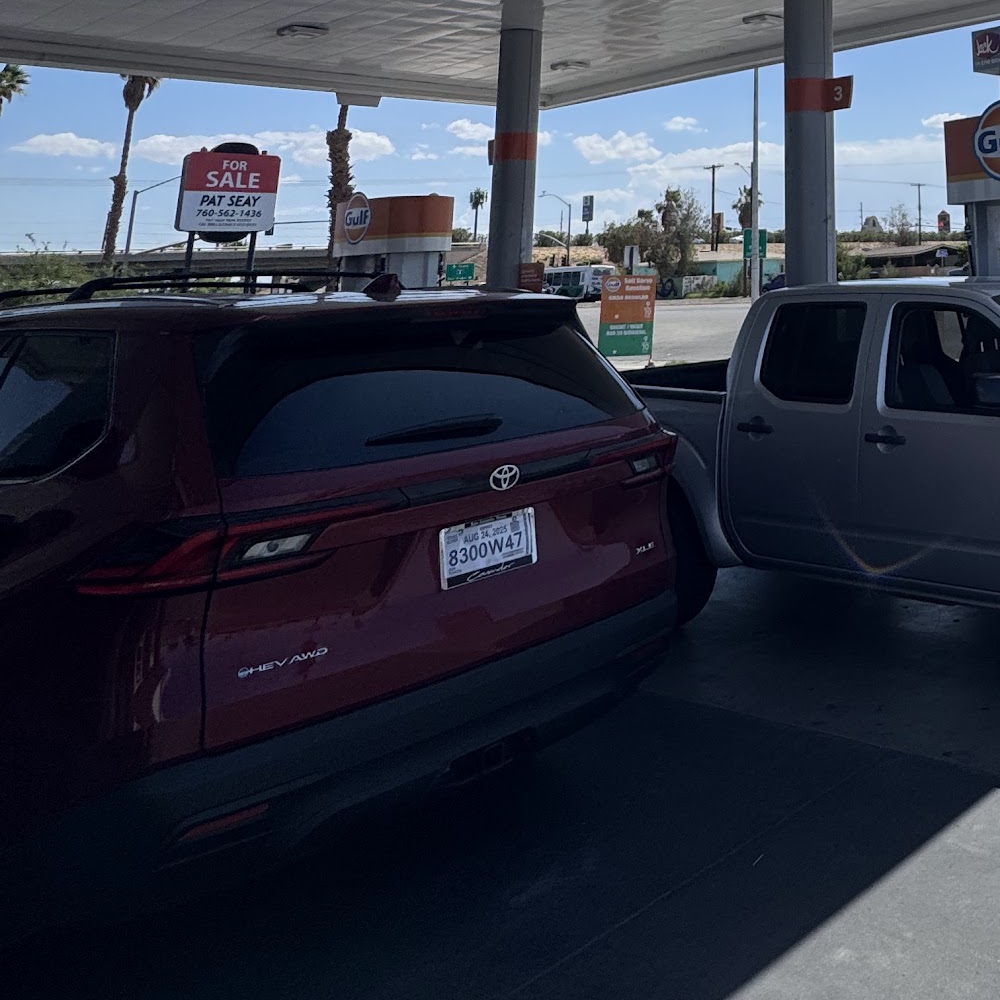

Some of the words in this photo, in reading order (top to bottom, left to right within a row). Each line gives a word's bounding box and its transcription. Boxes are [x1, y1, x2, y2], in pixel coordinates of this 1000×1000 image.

[976, 34, 1000, 56] Jack
[833, 86, 843, 101] 3
[222, 160, 248, 171] FOR
[205, 171, 261, 189] SALE
[200, 195, 225, 207] PAT
[227, 195, 262, 207] SEAY
[195, 208, 262, 218] 760-562-1436
[345, 209, 369, 226] Gulf
[464, 533, 480, 545] AUG
[493, 525, 508, 536] 2025
[448, 531, 522, 567] 8300W47
[289, 647, 328, 665] AWD
